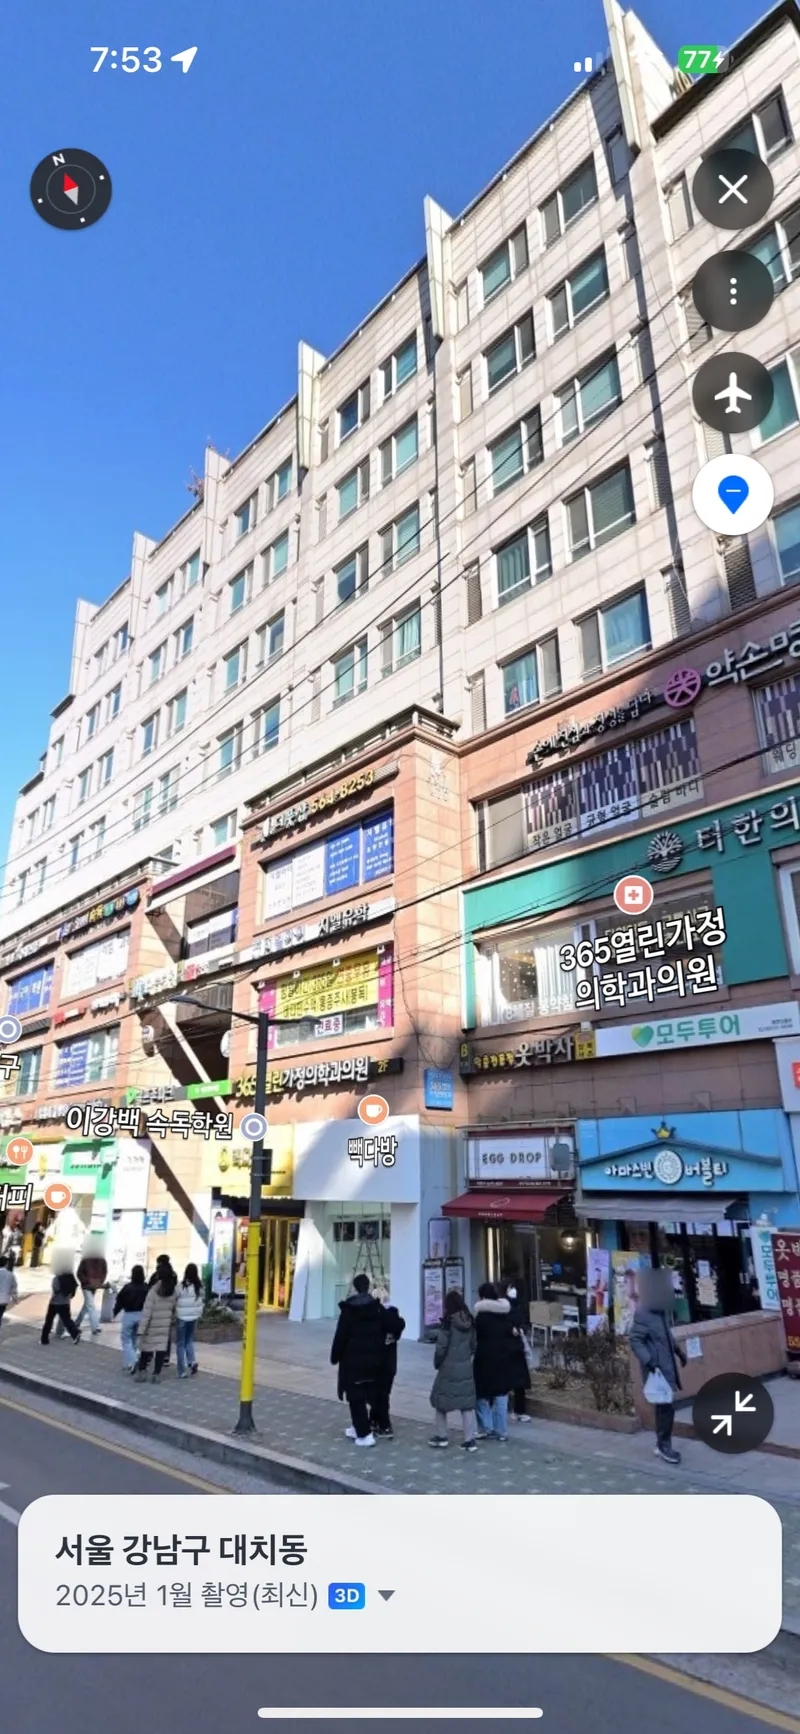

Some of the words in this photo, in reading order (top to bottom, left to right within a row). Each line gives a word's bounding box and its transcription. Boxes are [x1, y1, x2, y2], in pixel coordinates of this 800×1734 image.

[656, 1013, 741, 1046] 모두투어
[482, 1153, 505, 1165] EGG
[509, 1151, 542, 1164] DROP
[604, 1161, 653, 1179] 아마스빈
[684, 1157, 728, 1186] 버블티
